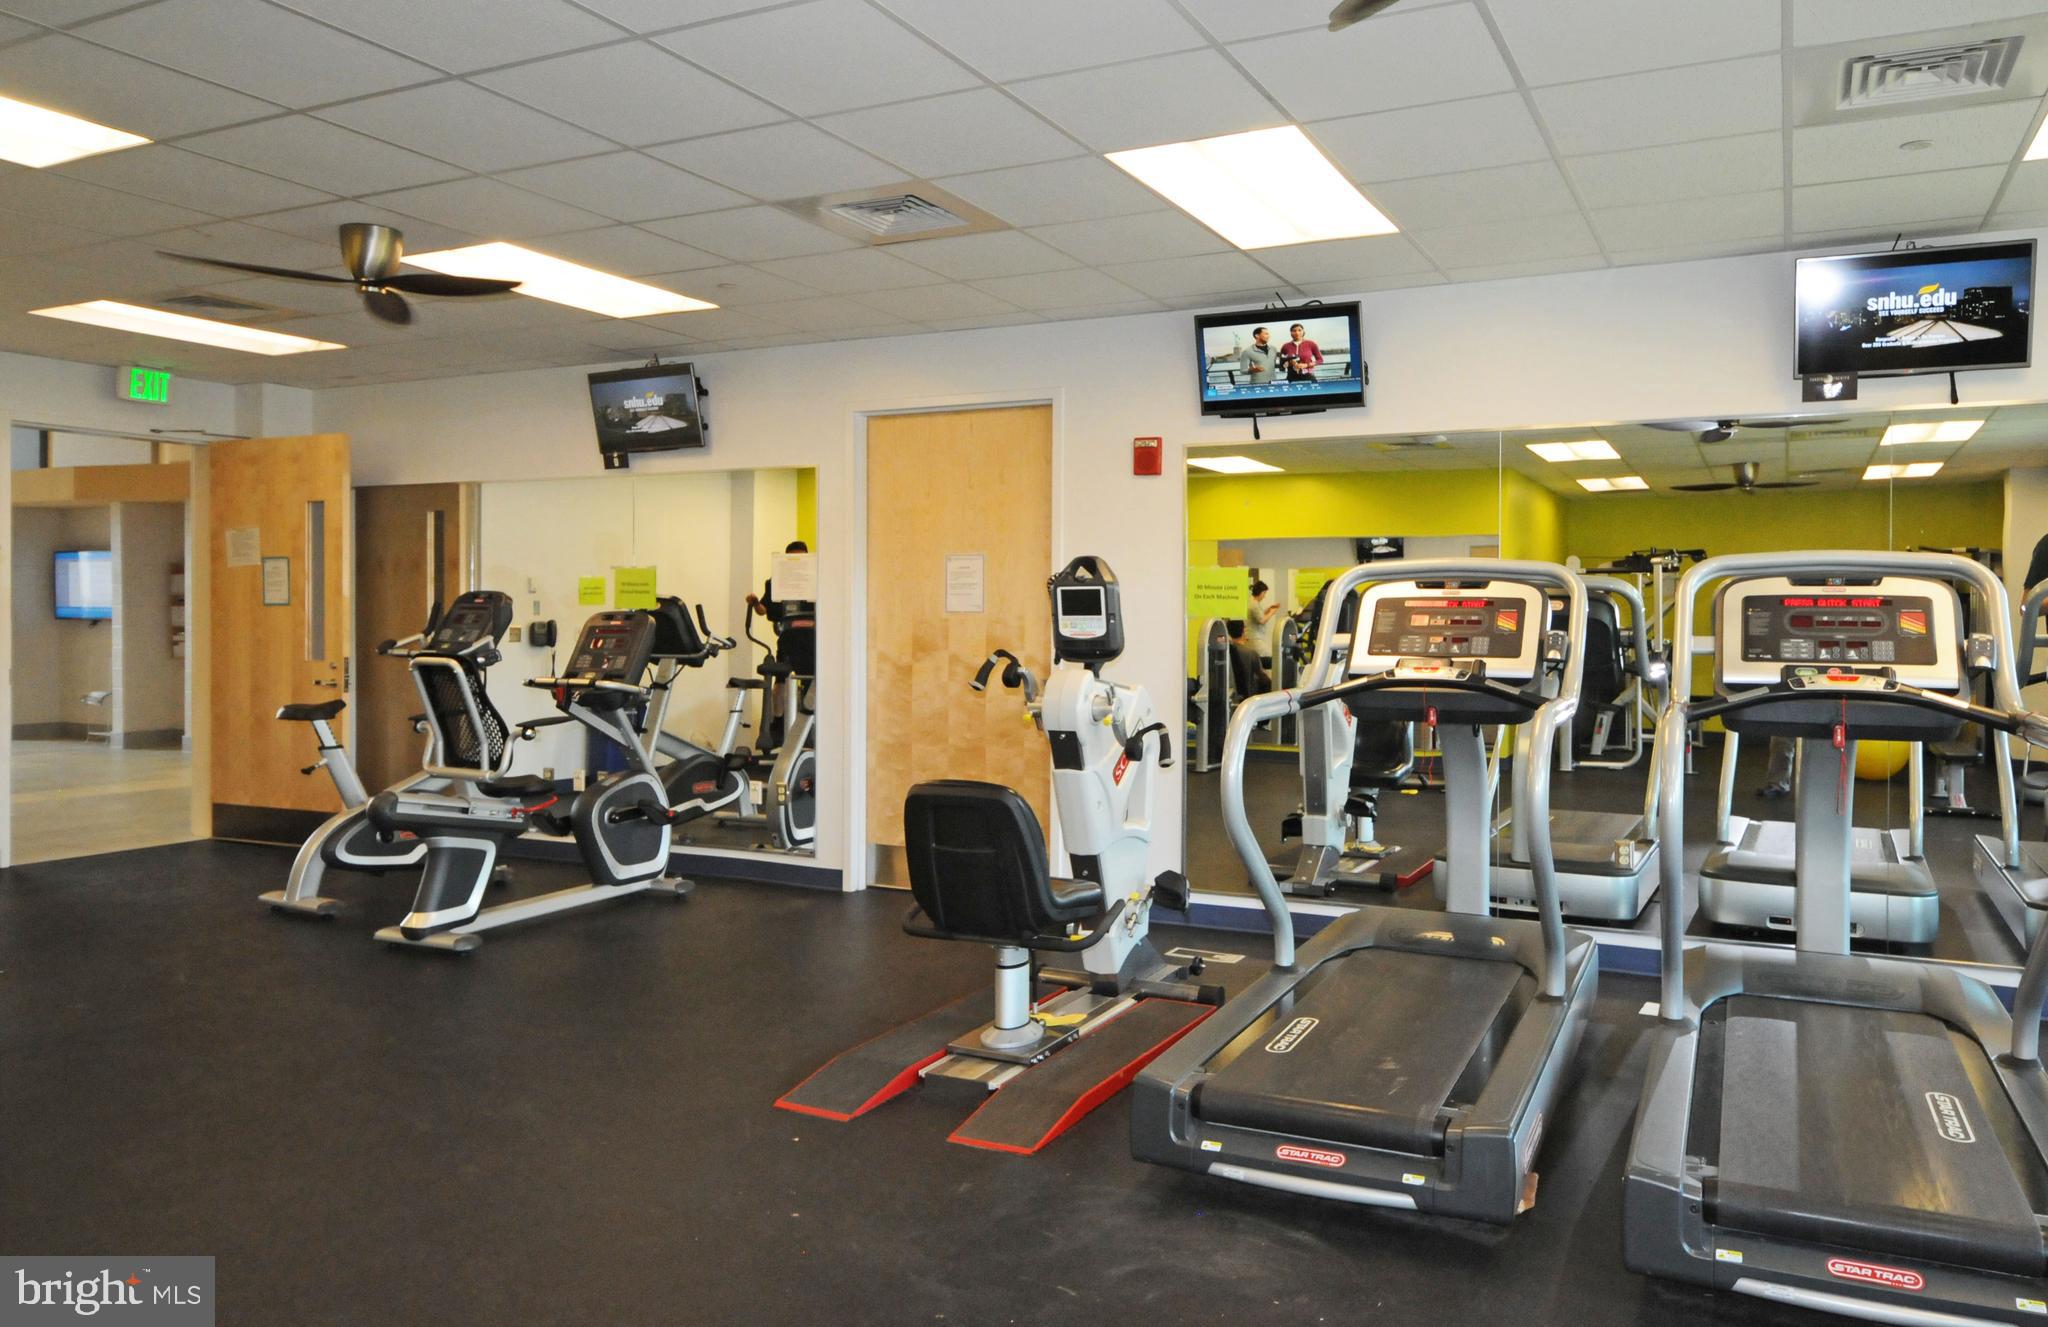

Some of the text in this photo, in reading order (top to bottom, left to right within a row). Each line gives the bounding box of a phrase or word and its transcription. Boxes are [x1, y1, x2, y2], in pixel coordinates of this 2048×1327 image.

[1866, 287, 1957, 312] snhu.edu
[1890, 308, 1918, 316] YOURSELF
[1919, 306, 1945, 314] SUCCEED
[130, 367, 171, 402] EXIT
[623, 394, 664, 409] snhu.edu
[1784, 598, 1881, 607] PRESS QUICK START
[1934, 1093, 1966, 1139] STAR TRAC
[1280, 1148, 1341, 1163] STAR TRAC
[1833, 1263, 1872, 1277] STAR
[1874, 1269, 1916, 1284] TRAC
